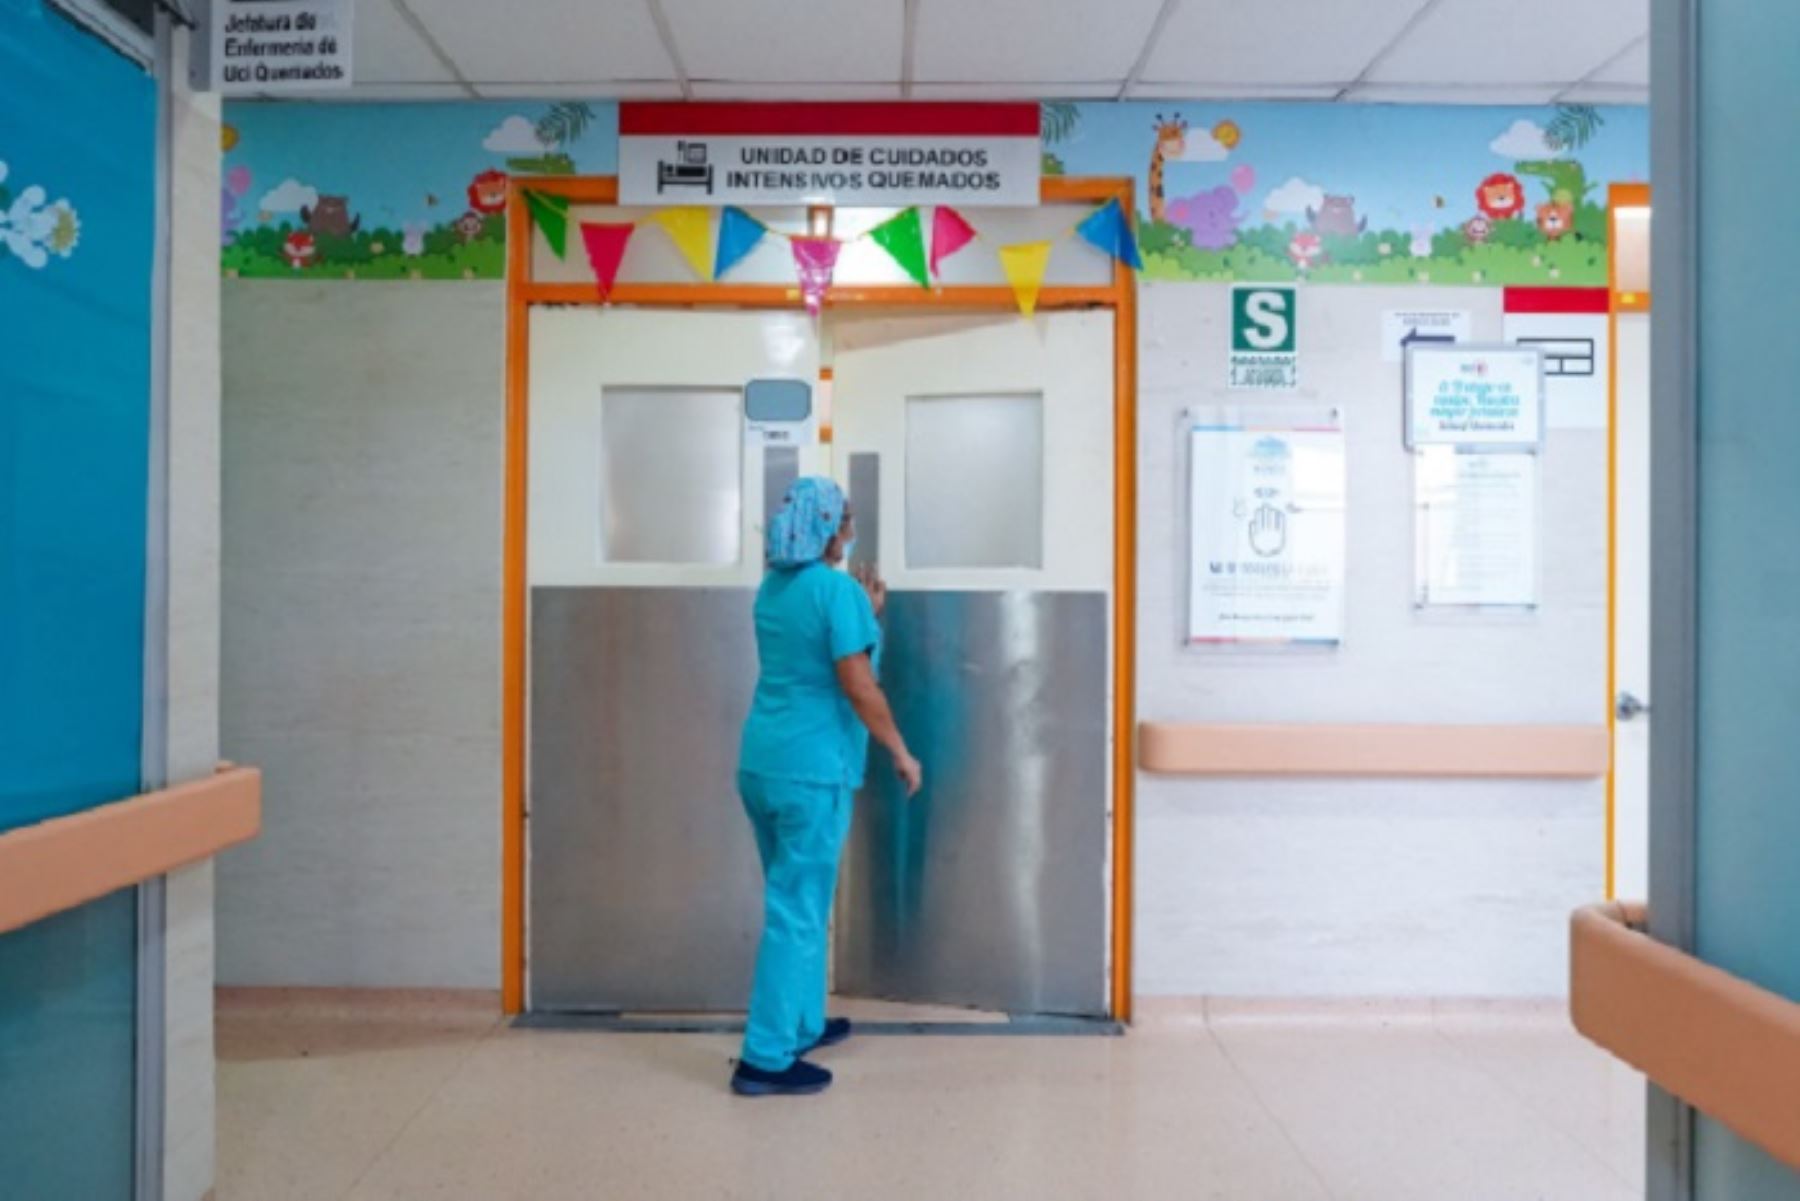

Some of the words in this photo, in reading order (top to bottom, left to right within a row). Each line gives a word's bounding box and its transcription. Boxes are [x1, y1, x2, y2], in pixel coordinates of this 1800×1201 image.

[741, 147, 826, 165] UNIDAD
[832, 147, 863, 165] DE
[870, 148, 988, 167] CUIDADOS
[727, 171, 863, 189] INTENSIVOS
[867, 172, 1001, 191] QUEMADOS
[1243, 290, 1288, 349] S
